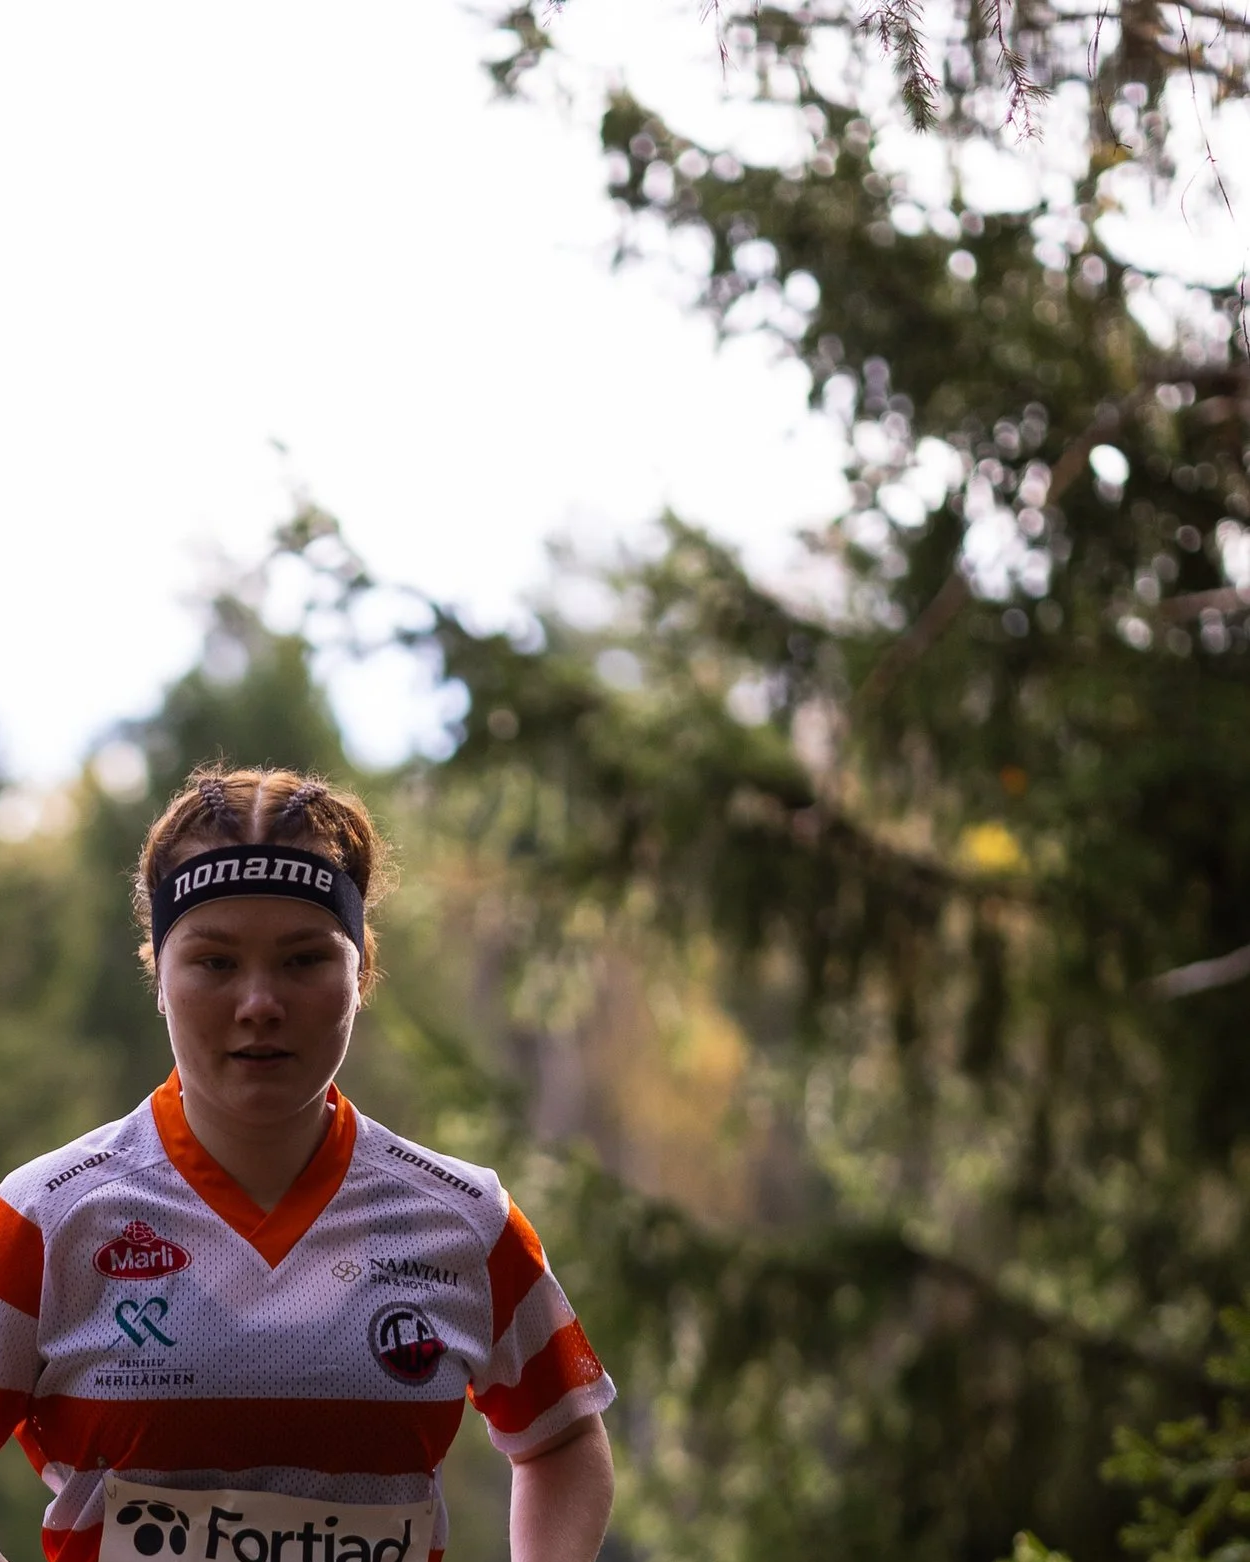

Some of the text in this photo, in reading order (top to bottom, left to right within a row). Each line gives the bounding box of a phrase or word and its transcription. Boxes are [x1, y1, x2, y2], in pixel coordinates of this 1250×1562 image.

[174, 857, 333, 902] noname
[385, 1144, 483, 1199] noname
[110, 1245, 174, 1271] Marli
[369, 1258, 459, 1287] NAANTALI
[370, 1274, 391, 1286] SPA
[402, 1279, 438, 1293] HOTEL
